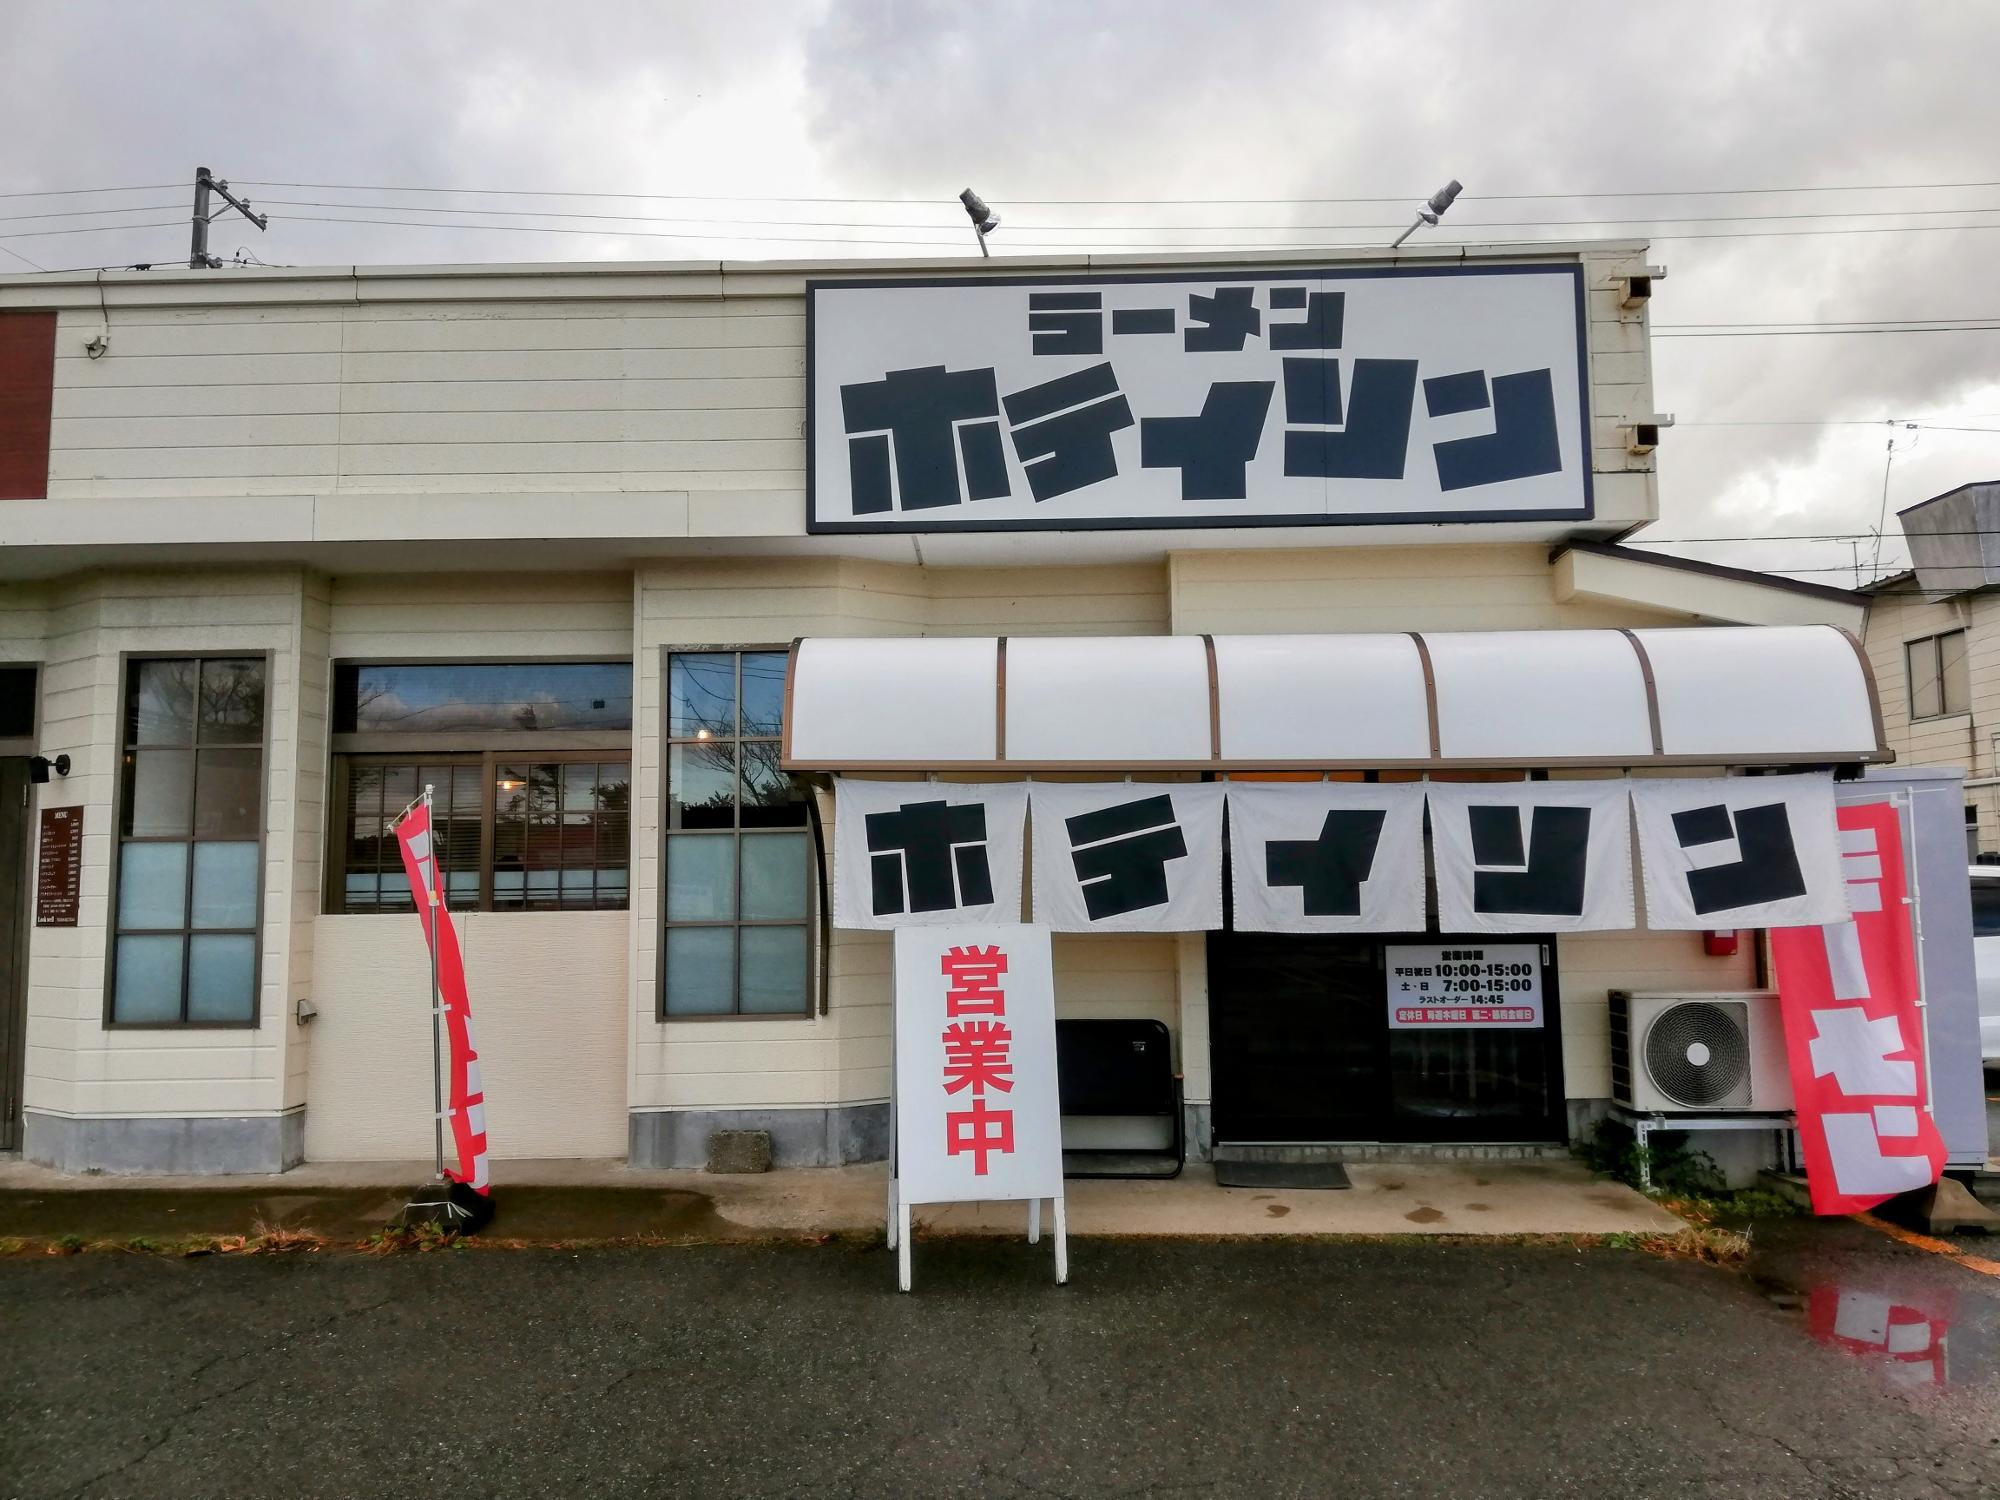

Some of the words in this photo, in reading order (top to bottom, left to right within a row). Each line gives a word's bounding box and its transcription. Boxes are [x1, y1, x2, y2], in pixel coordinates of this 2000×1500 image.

[1029, 287, 1345, 355] ラーメン
[1435, 963, 1532, 977] 10:00-15:00
[1443, 979, 1532, 992] 7:00-15:00
[1419, 996, 1468, 1004] ラストオーダー
[1471, 995, 1504, 1004] 14:45
[941, 944, 1015, 1176] 営業中
